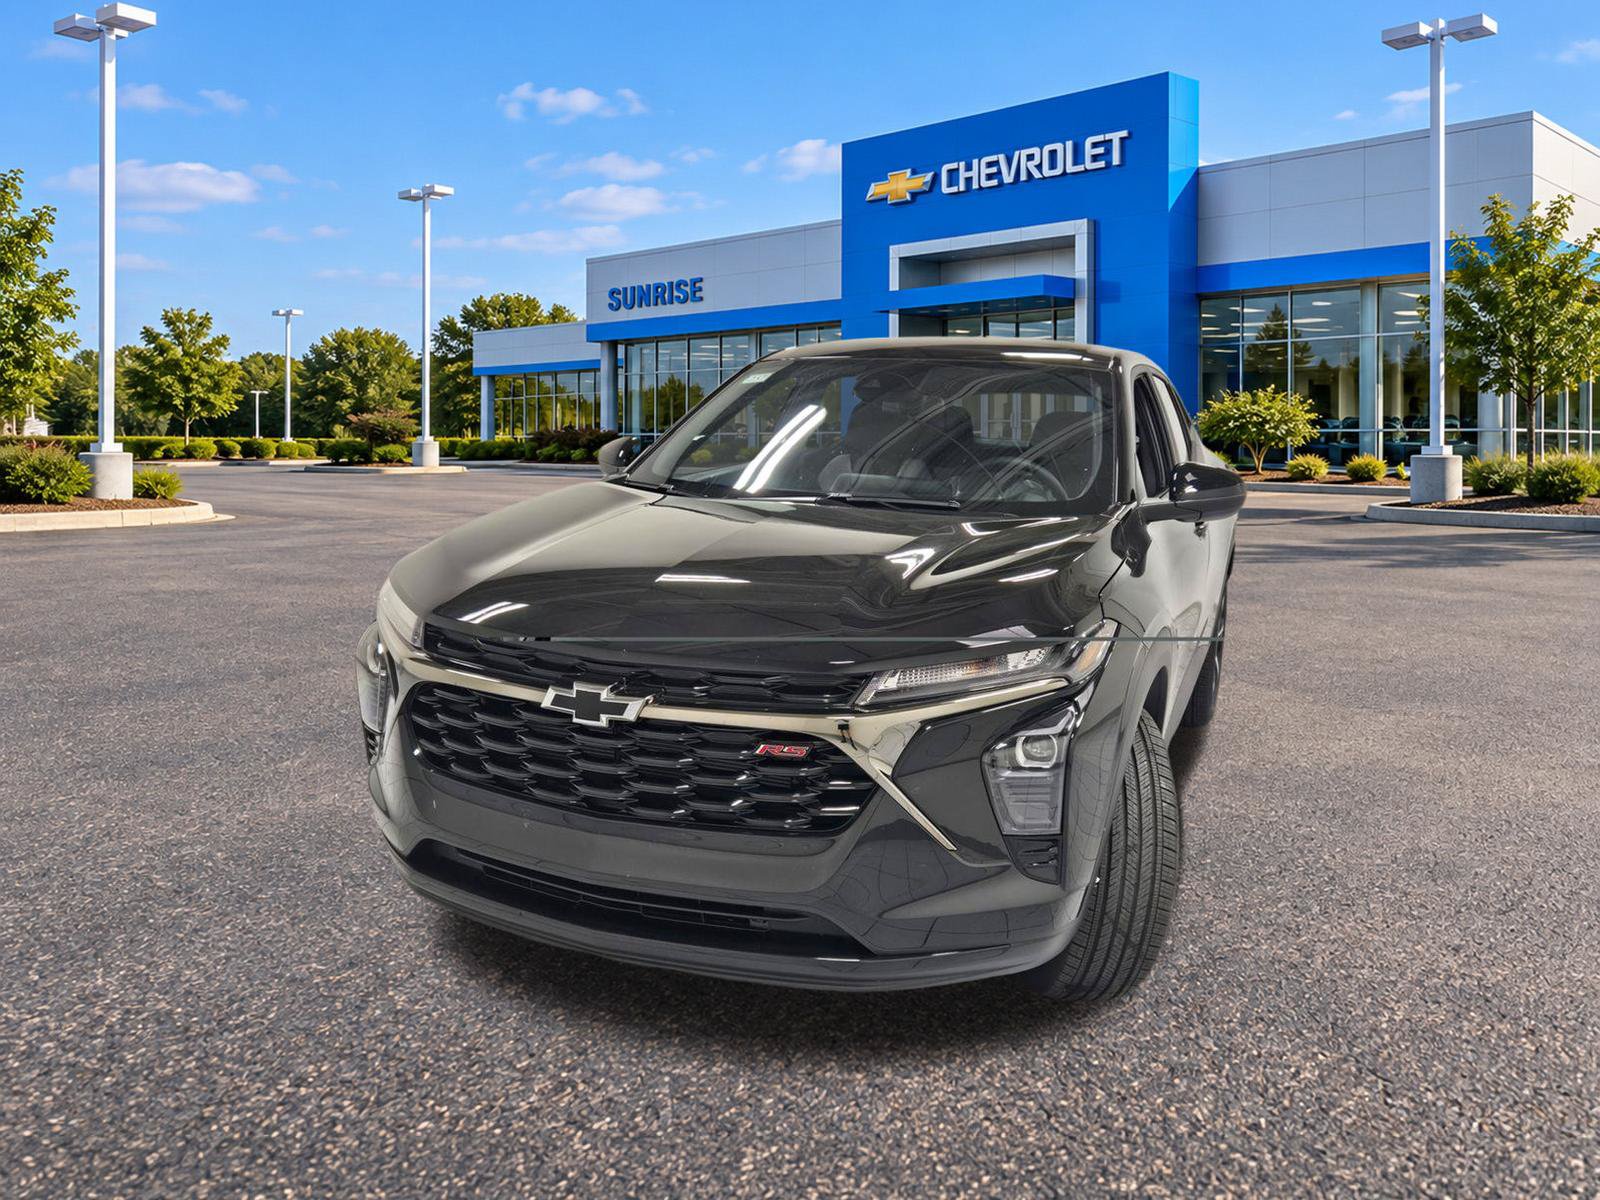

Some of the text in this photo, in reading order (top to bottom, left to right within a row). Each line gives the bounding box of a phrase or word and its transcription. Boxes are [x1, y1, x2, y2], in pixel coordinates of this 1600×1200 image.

[940, 130, 1129, 195] CHEVROLET
[608, 277, 704, 312] SUNRISE
[755, 744, 809, 758] RS
